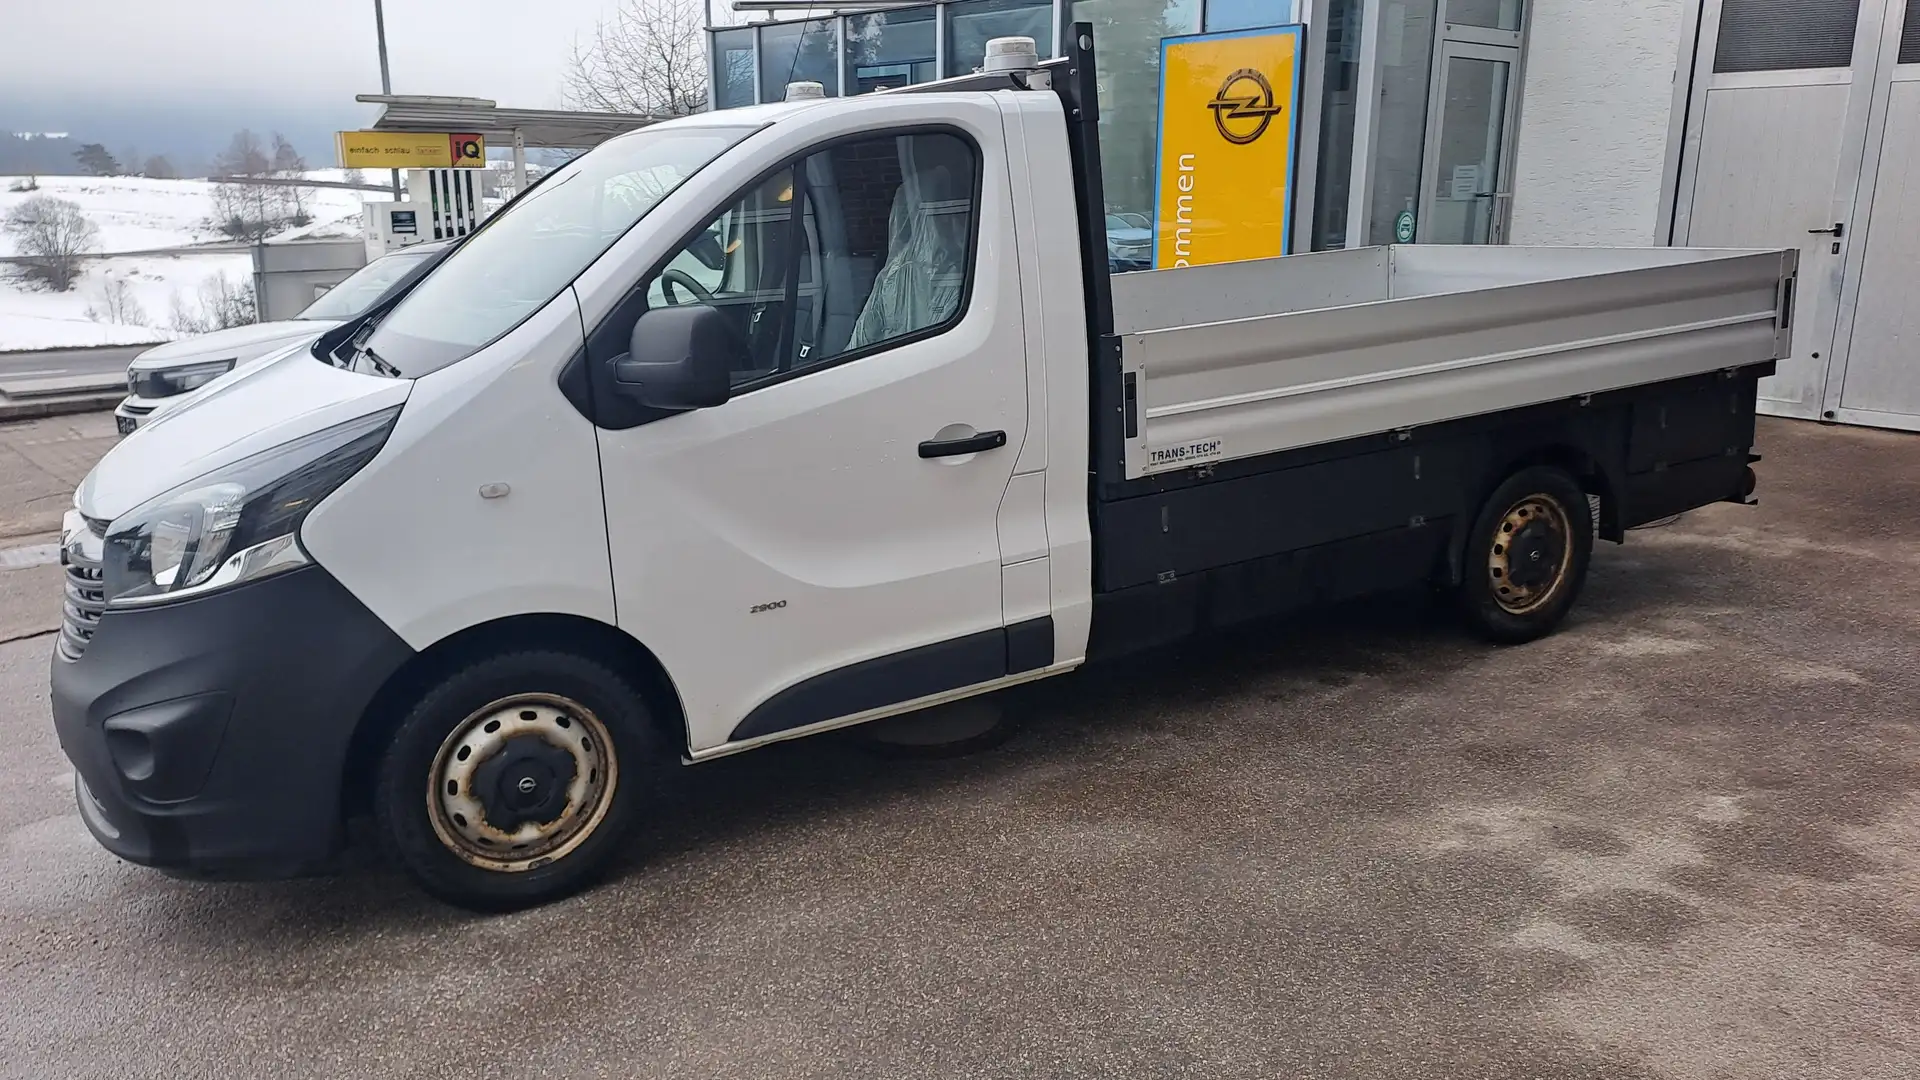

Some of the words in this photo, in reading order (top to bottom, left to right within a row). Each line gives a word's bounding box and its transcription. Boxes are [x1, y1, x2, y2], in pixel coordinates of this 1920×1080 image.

[349, 146, 380, 154] einfach
[384, 146, 411, 154] schlau
[455, 140, 481, 159] iQ
[750, 599, 787, 614] 2900
